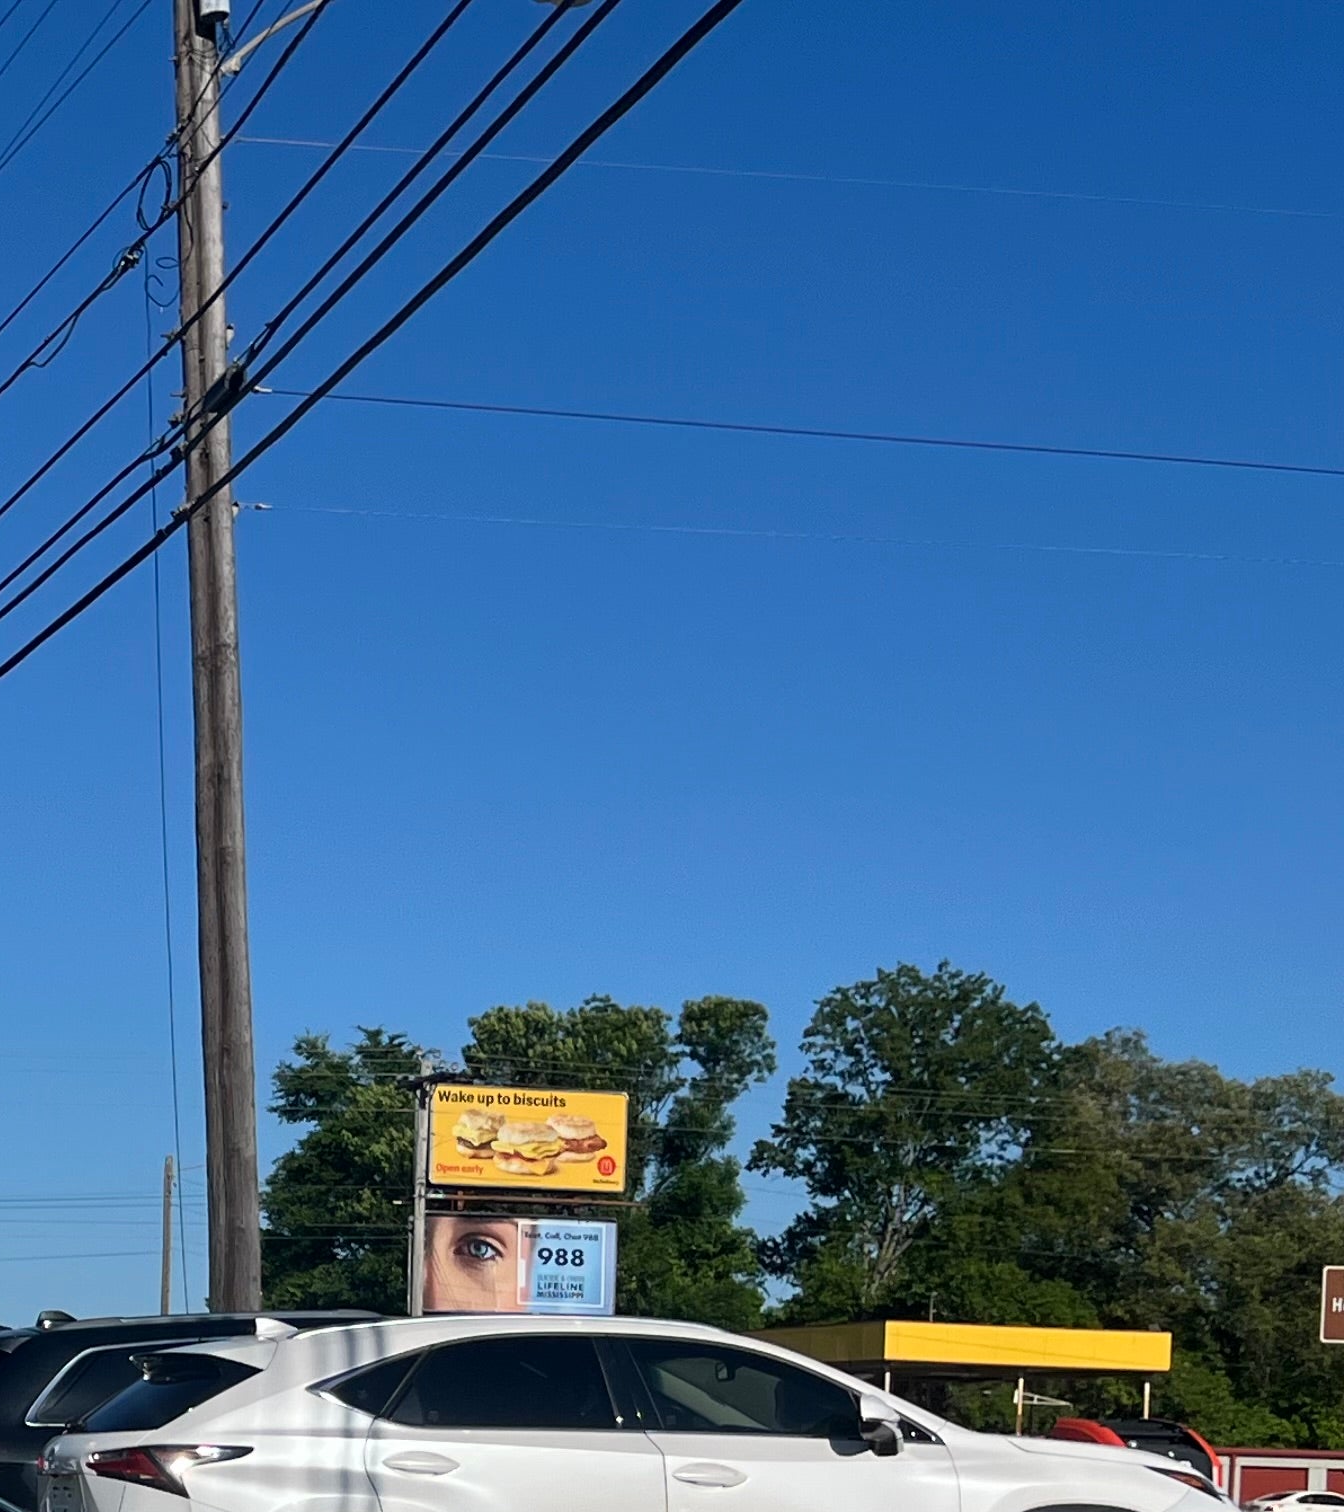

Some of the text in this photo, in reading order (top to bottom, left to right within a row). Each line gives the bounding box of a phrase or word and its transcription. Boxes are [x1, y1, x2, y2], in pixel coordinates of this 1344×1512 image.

[438, 1090, 567, 1108] Wake up to biscuits
[435, 1163, 484, 1175] Open early
[537, 1247, 585, 1267] 988
[537, 1281, 584, 1292] LIFELINE
[1331, 1296, 1344, 1313] H
